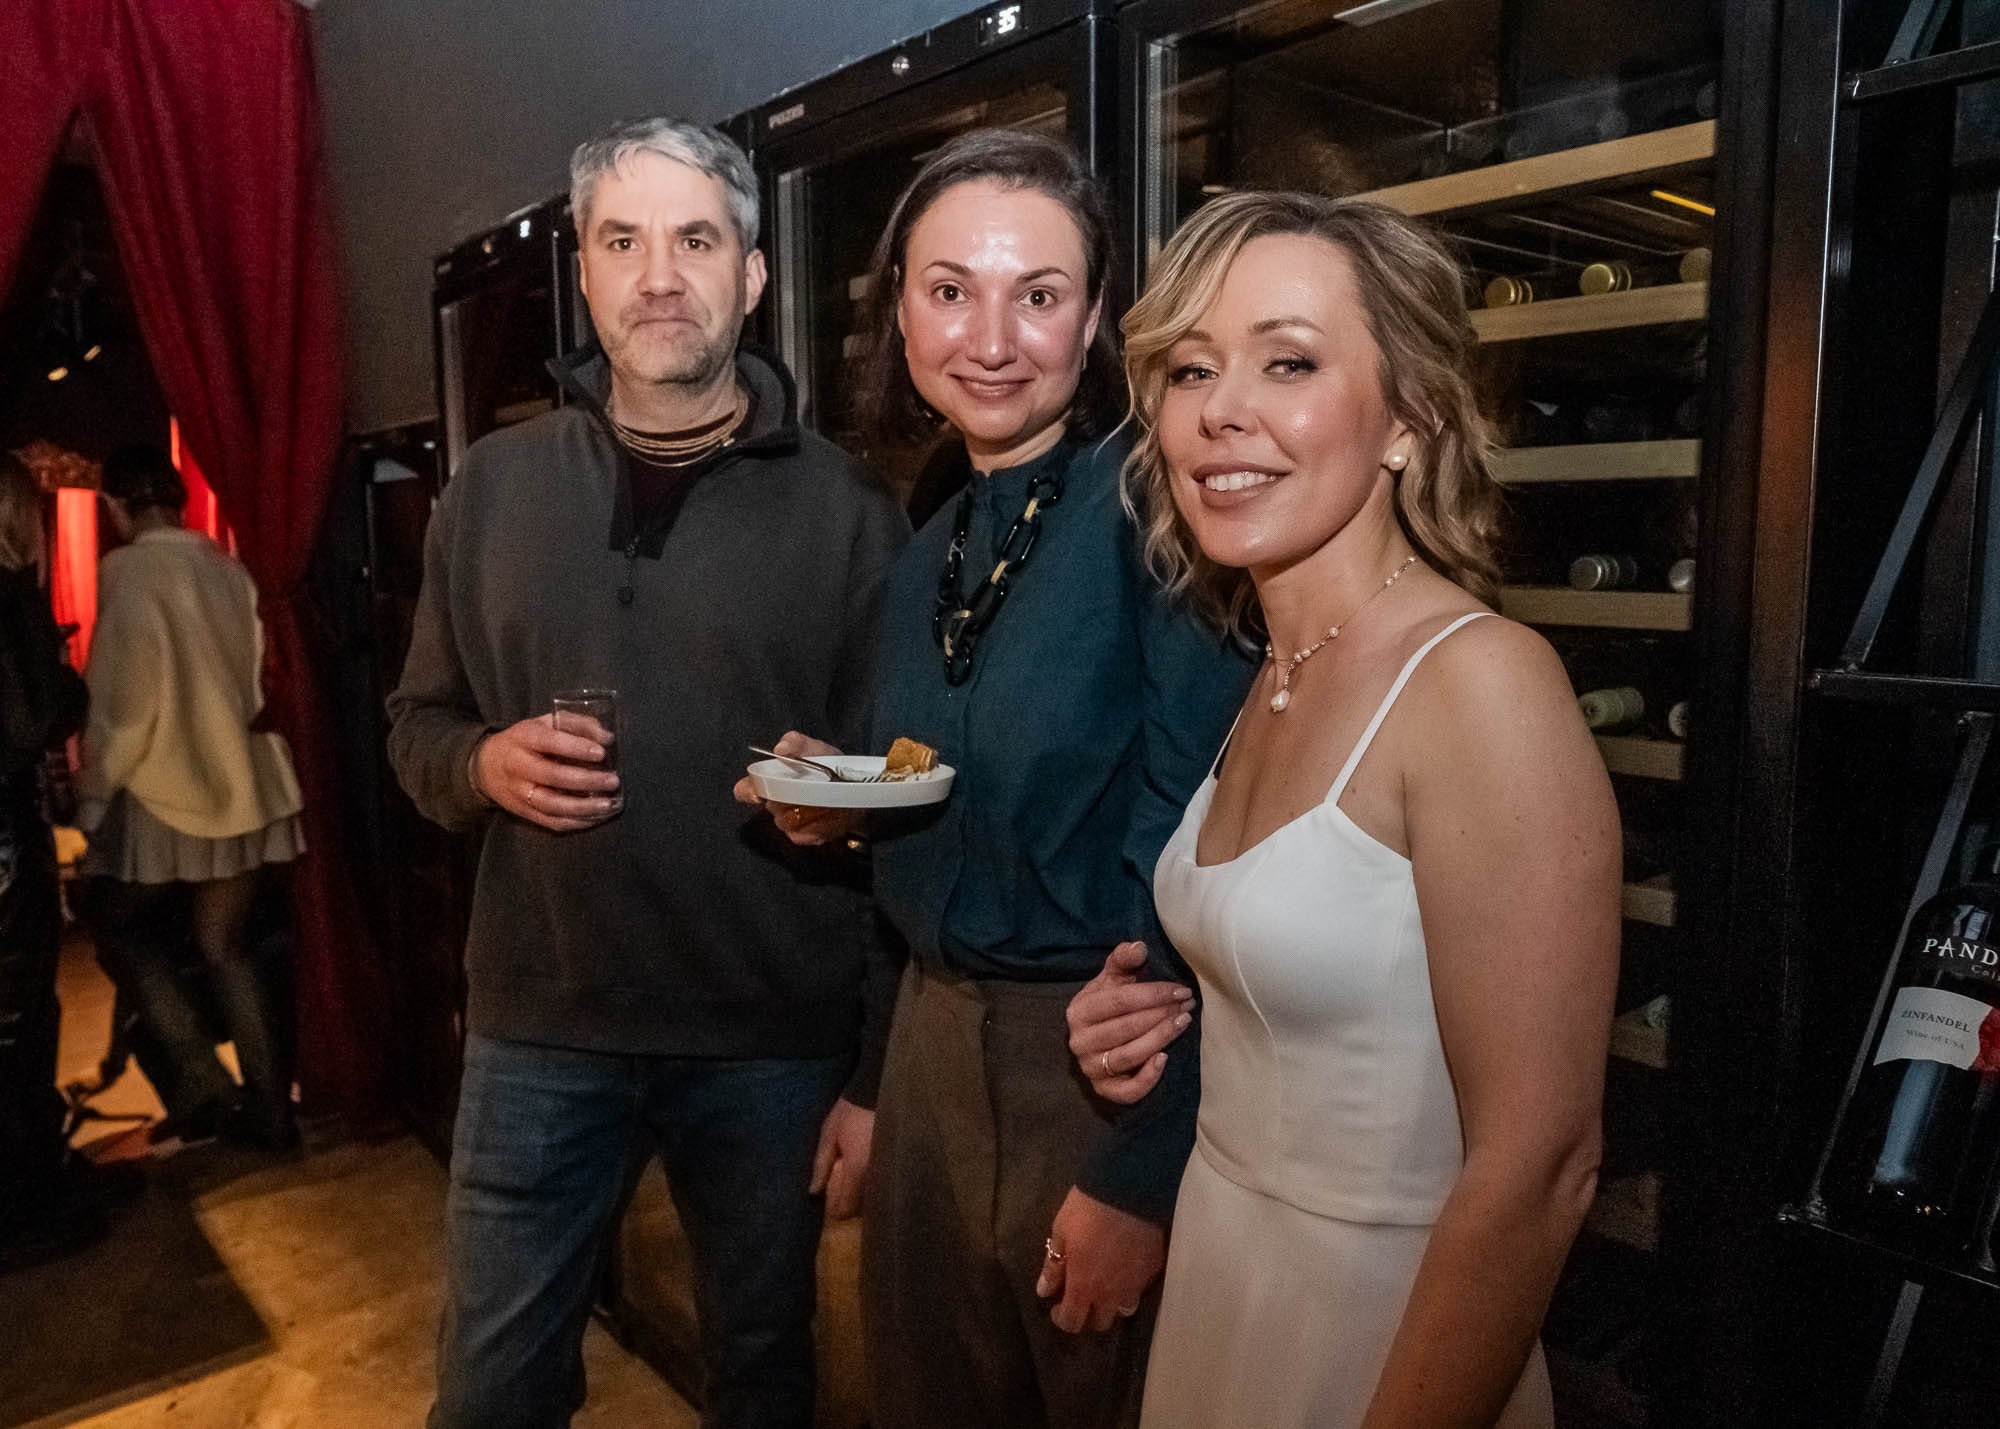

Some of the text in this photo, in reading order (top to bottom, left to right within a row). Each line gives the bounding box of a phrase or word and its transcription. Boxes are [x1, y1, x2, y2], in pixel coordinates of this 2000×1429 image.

[1901, 1010, 1970, 1032] ZINFANDEL
[1906, 1029, 1966, 1050] Wine of USA
